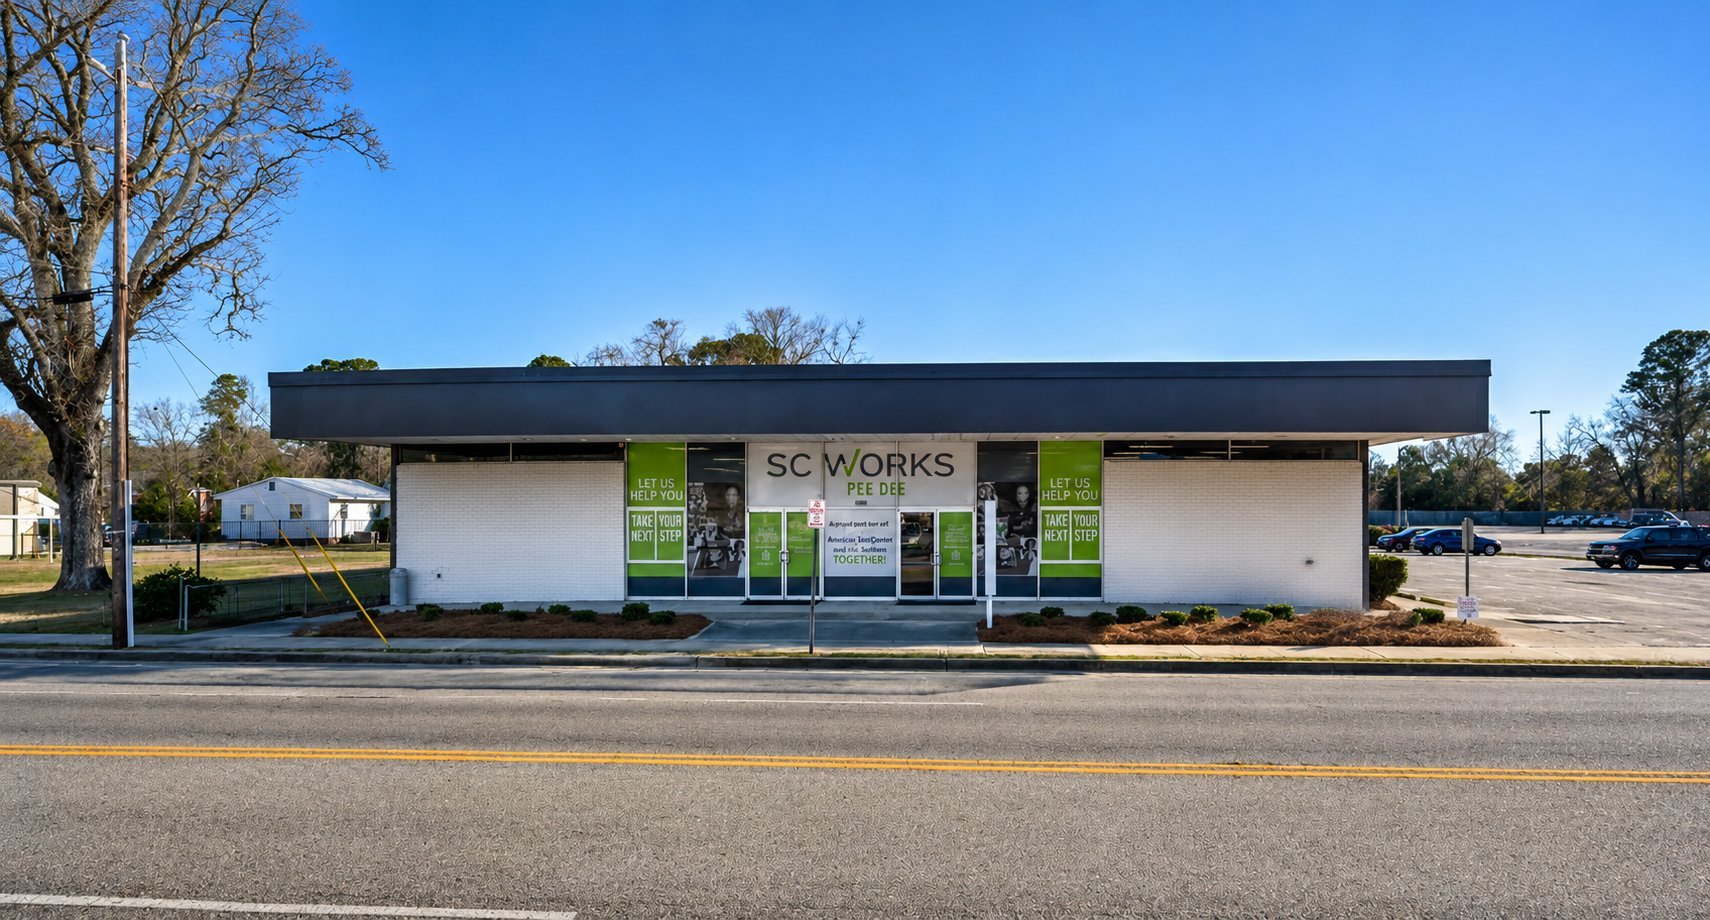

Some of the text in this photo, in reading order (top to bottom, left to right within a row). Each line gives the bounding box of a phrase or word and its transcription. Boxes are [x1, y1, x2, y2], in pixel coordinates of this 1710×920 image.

[767, 448, 955, 477] SC WORKS
[638, 478, 675, 489] LET US
[1050, 477, 1090, 488] LET US
[847, 482, 906, 496] PEE DEE
[1042, 489, 1098, 501] HELP YOU
[630, 490, 683, 501] HELP YOU
[631, 514, 682, 528] TAKE YOUR
[1044, 513, 1098, 527] TAKE YOUR
[631, 530, 681, 542] NEXT STEP
[1074, 529, 1098, 542] STEP
[833, 554, 887, 565] TOGETHER!
